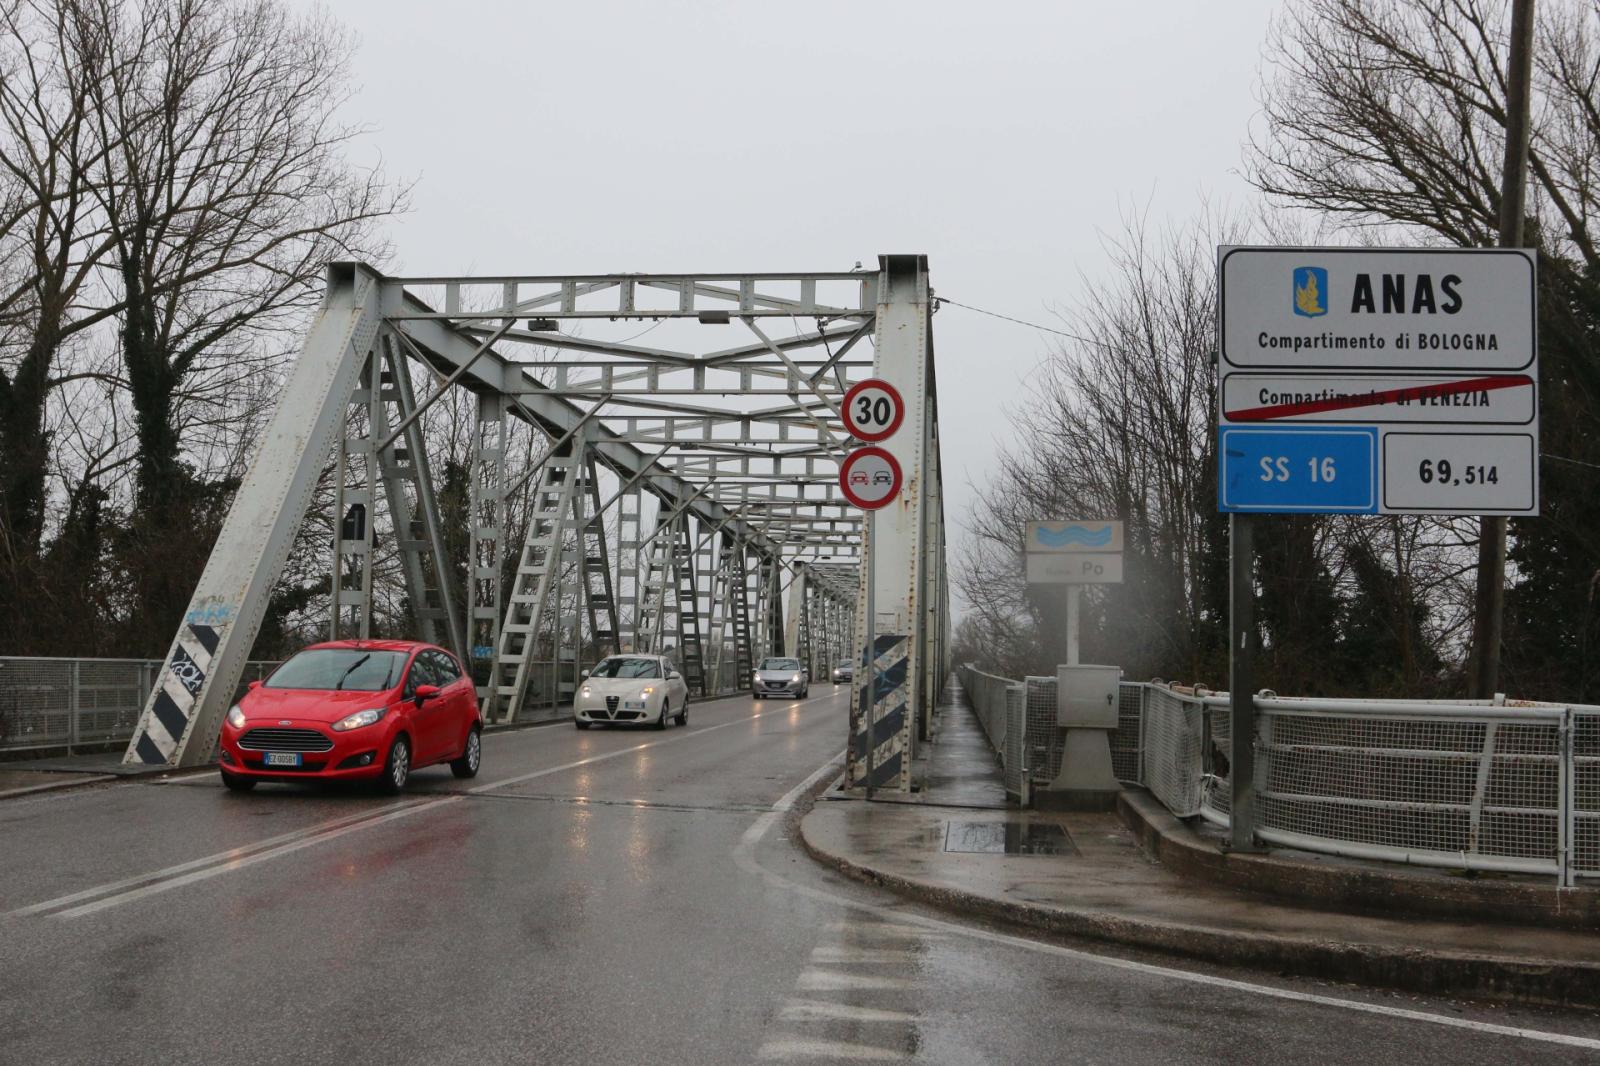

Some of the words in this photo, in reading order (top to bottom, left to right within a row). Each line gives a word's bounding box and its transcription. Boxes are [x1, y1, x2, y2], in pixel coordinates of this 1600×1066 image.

[1350, 273, 1463, 315] ANAS
[1258, 331, 1386, 353] Compartimento
[1395, 333, 1410, 349] di
[1418, 333, 1499, 351] BOLOGNA
[856, 396, 891, 426] 30
[1258, 387, 1386, 409] Compartim
[1259, 456, 1290, 482] SS
[1308, 456, 1336, 483] 16
[1419, 458, 1499, 487] 69,514
[1082, 561, 1105, 577] Po
